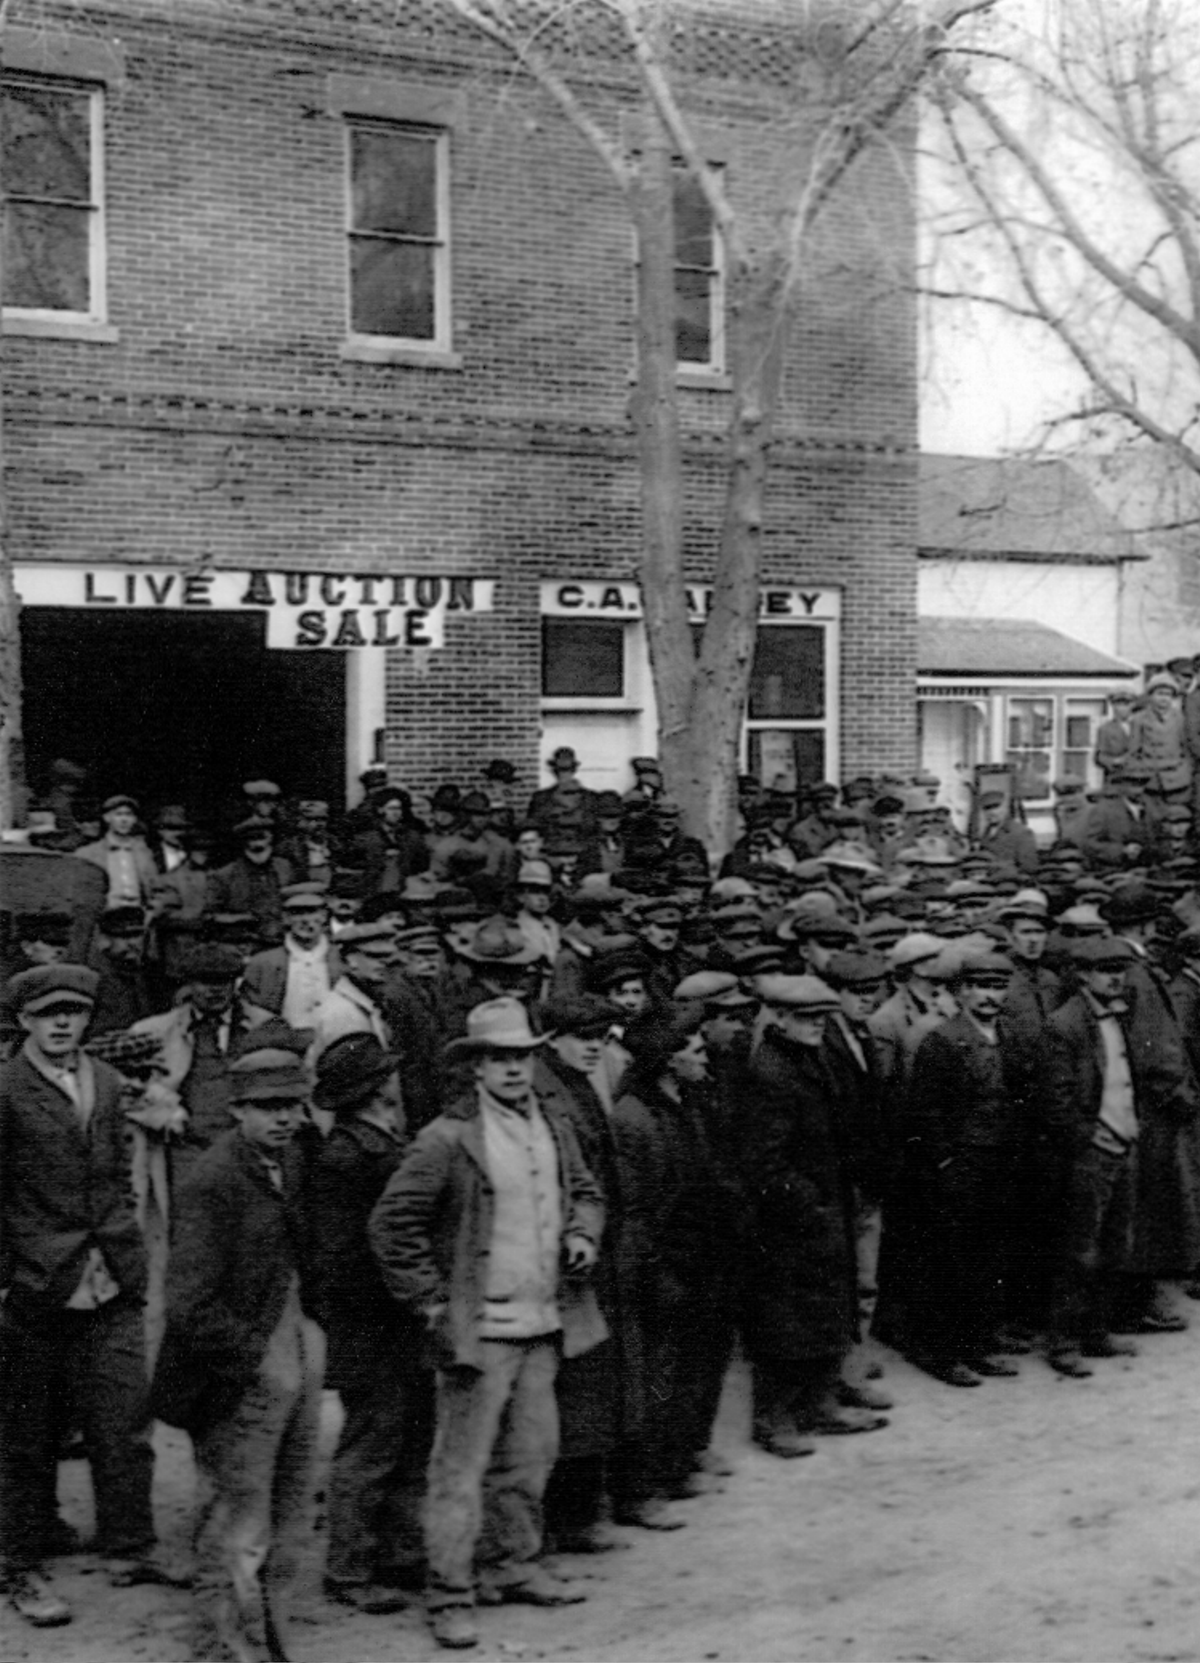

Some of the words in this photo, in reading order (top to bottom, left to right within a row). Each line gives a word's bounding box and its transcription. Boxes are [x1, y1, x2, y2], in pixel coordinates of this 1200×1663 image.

[85, 573, 215, 605] LIVE
[241, 572, 474, 611] AUCTION
[295, 609, 433, 646] SALE
